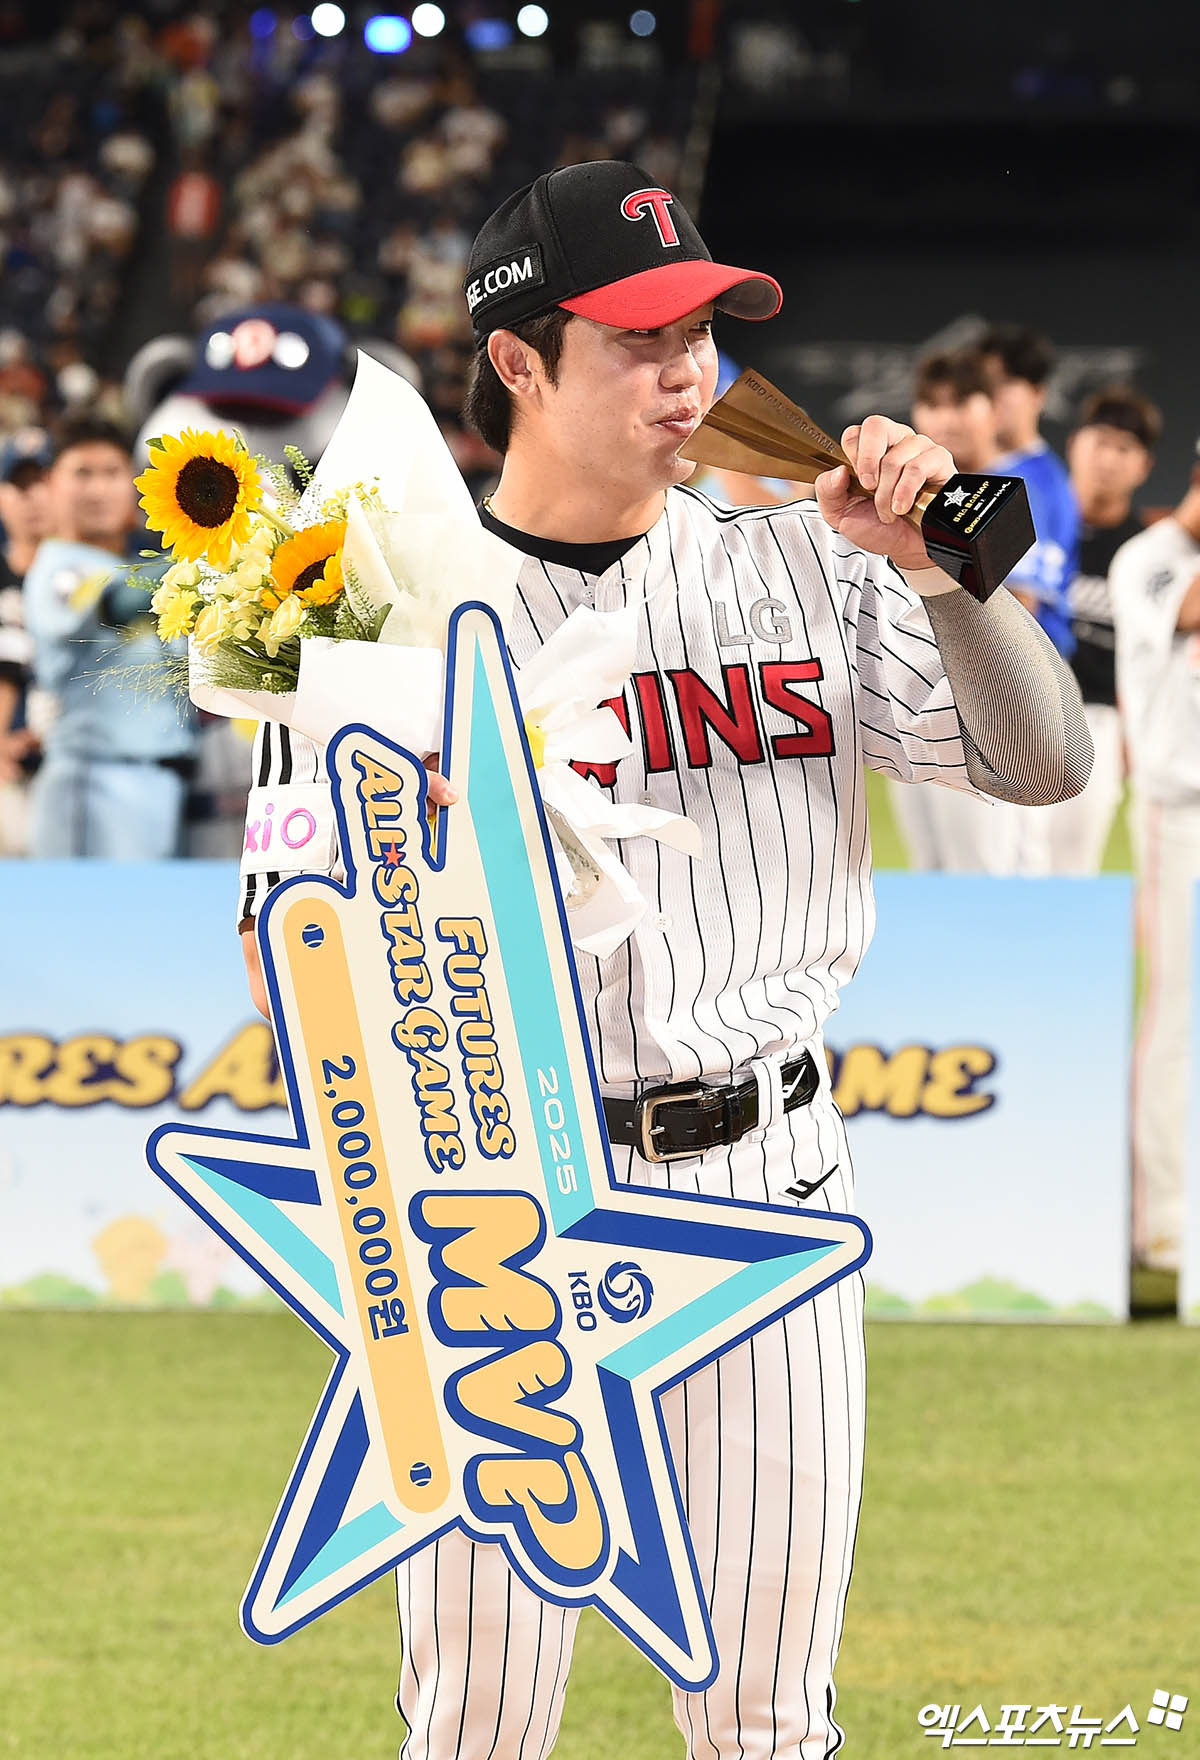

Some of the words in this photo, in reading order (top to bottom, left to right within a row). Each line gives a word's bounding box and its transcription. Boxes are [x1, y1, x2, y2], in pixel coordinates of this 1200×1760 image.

[620, 188, 681, 248] T
[715, 597, 793, 647] LG
[568, 657, 836, 788] INS
[391, 1006, 466, 1174] GAME
[435, 916, 516, 1160] FUTURES
[824, 1042, 998, 1118] ME
[537, 1066, 578, 1195] 2025
[322, 1055, 409, 1340] 2,000,000원
[568, 1270, 598, 1332] KBO
[408, 1189, 611, 1587] MVP
